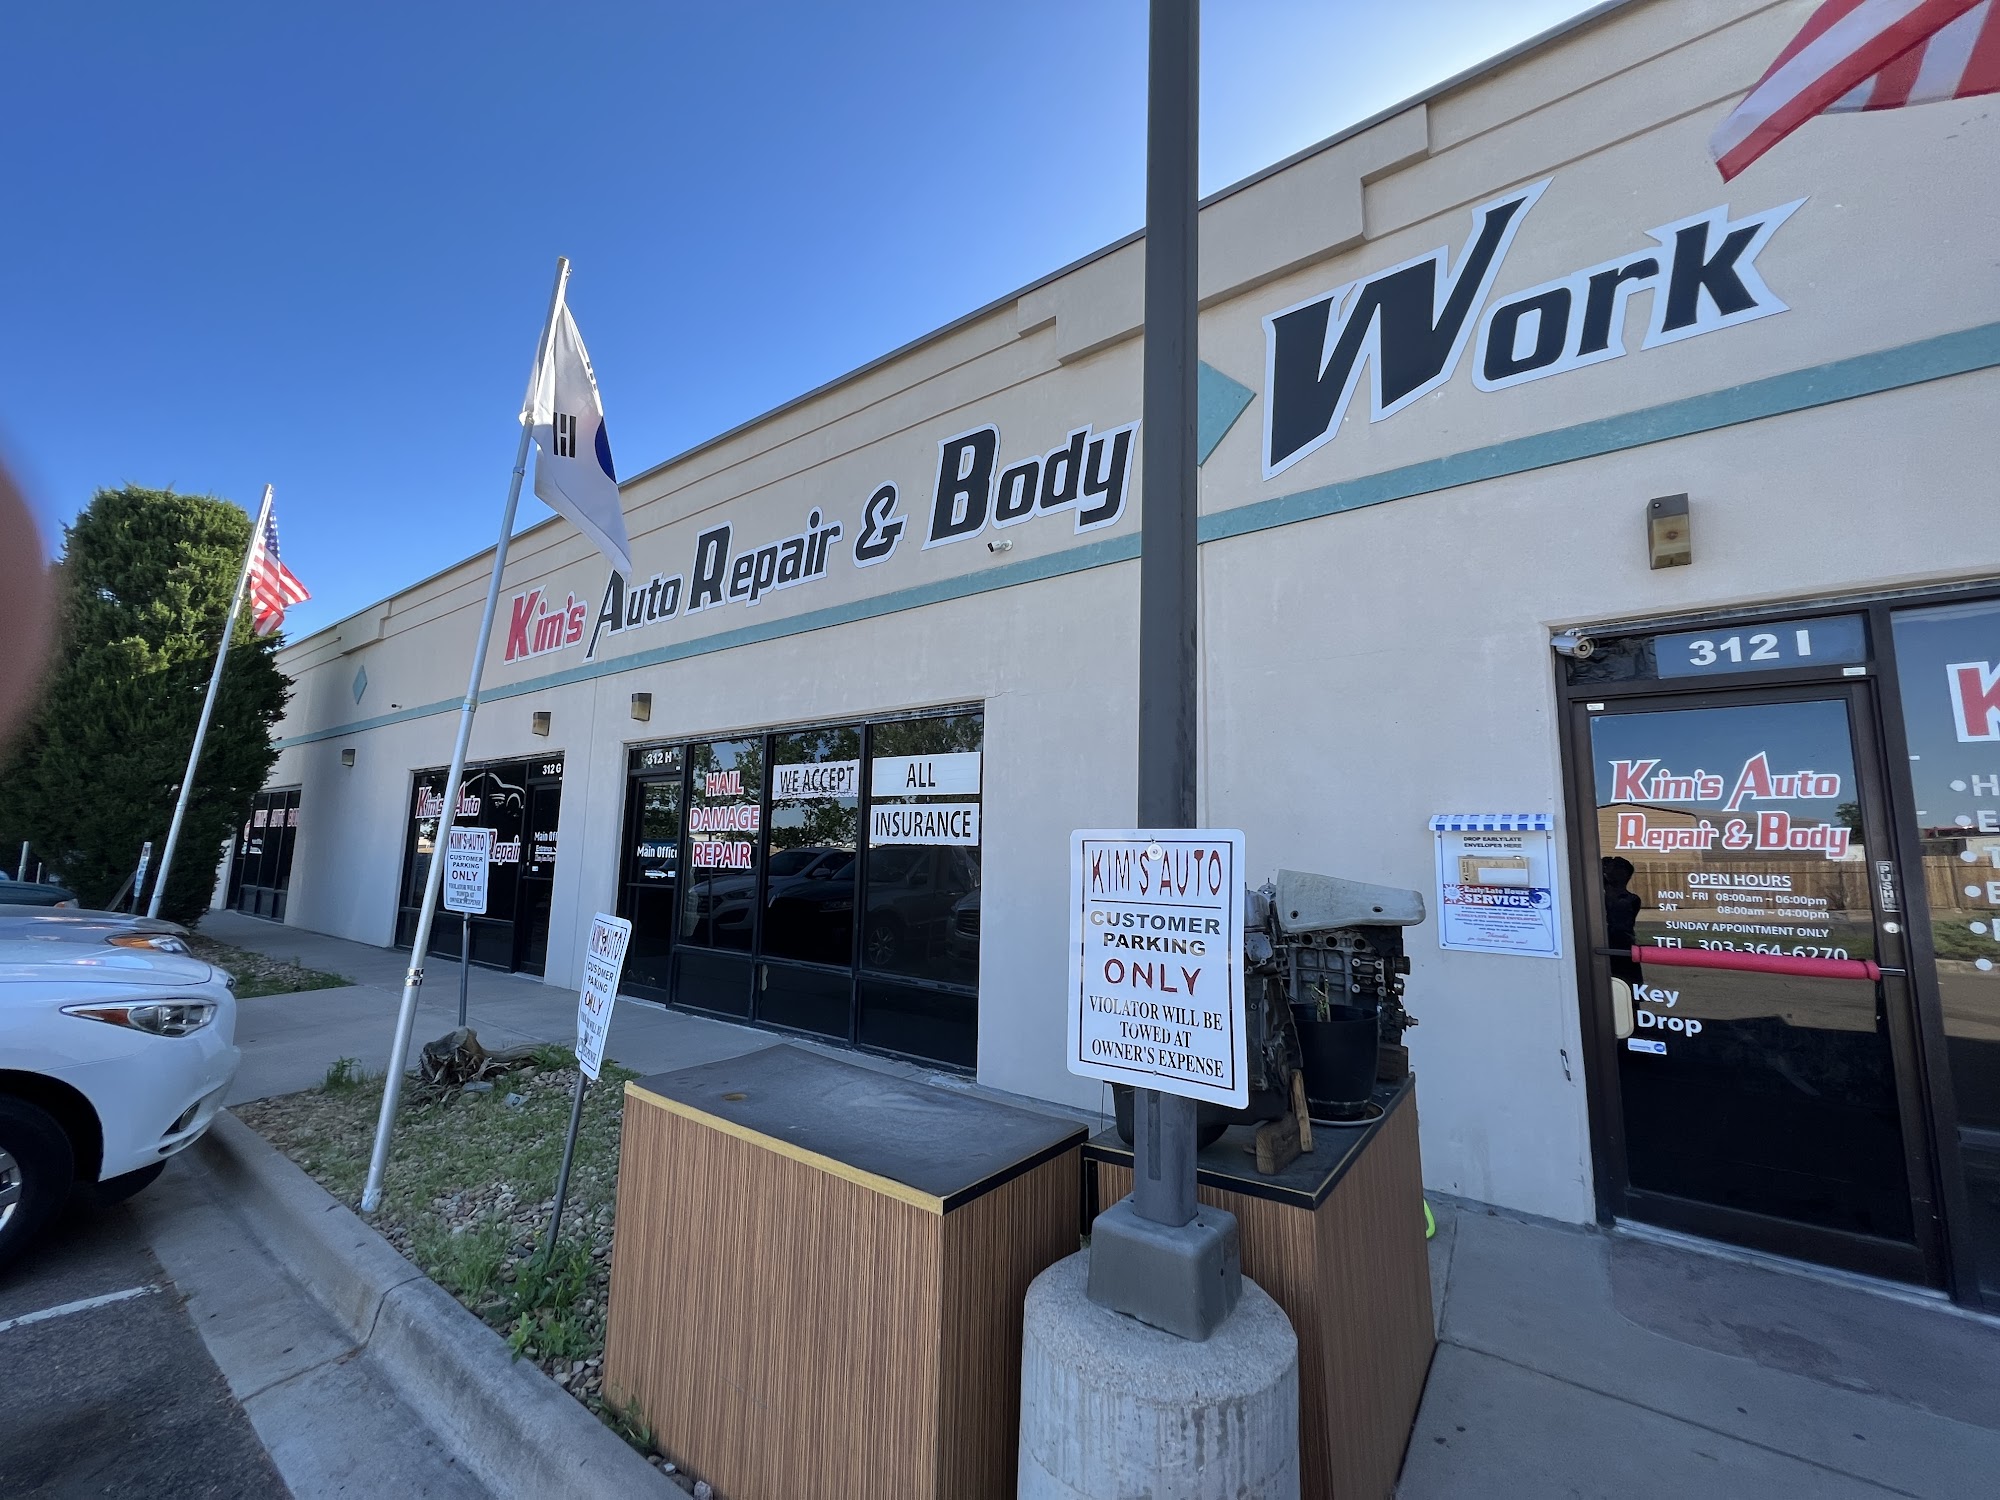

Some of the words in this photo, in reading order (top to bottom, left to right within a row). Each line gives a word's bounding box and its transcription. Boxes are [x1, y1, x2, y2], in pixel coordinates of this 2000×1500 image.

[504, 585, 587, 665] Kim's
[583, 568, 683, 662] Auto
[685, 508, 842, 614] Repair
[855, 481, 907, 567] &
[923, 421, 1140, 549] Body
[1265, 183, 1795, 476] Work
[1688, 633, 1780, 666] 312
[542, 764, 555, 775] 312
[647, 752, 663, 765] 312
[706, 771, 744, 797] HAIL
[780, 770, 799, 793] WE
[802, 766, 855, 792] ACCEPT
[906, 762, 935, 788] ALL
[1608, 758, 1724, 803] Kim's
[1722, 750, 1841, 811] Auto
[452, 781, 480, 825] Auto
[689, 805, 760, 832] DAMAGE
[875, 810, 971, 838] INSURANCE
[469, 834, 485, 851] AUTO
[1615, 812, 1719, 853] Repair
[1722, 819, 1753, 850] &
[1755, 810, 1851, 860] Body
[450, 854, 483, 862] CUSTOMER
[637, 845, 655, 858] Main
[692, 841, 751, 869] REPAIR
[452, 861, 480, 869] PARKING
[452, 870, 478, 881] ONLY
[1091, 849, 1151, 896] KIM'S
[1159, 849, 1222, 898] AUTO
[1687, 872, 1731, 887] OPEN
[1734, 874, 1792, 888] HOURS
[1880, 865, 1894, 898] PUSH
[1464, 894, 1530, 906] SERVICE
[1658, 890, 1684, 900] MON
[1692, 891, 1709, 901] FRI
[1715, 892, 1763, 903] 08:00am
[1775, 895, 1827, 907] 06:00pm
[1658, 903, 1677, 912] SAT
[1717, 905, 1765, 916] 08:00am
[1777, 908, 1829, 920] 04:00pm
[1090, 910, 1221, 935] CUSTOMER
[1665, 920, 1709, 932] SUNDAY
[1711, 923, 1794, 936] APPOINTMENT
[1796, 926, 1830, 938] ONLY
[1103, 932, 1206, 957] PARKING
[1104, 958, 1202, 996] ONLY
[1632, 983, 1679, 1008] Key
[1089, 995, 1160, 1020] VIOLATOR
[1162, 1004, 1199, 1027] WILL
[1203, 1011, 1223, 1031] BE
[1636, 1010, 1703, 1037] Drop
[1119, 1020, 1171, 1045] TOWED
[1173, 1031, 1192, 1048] AT
[1091, 1038, 1155, 1065] OWNER'S
[1158, 1049, 1224, 1079] EXPENSE
